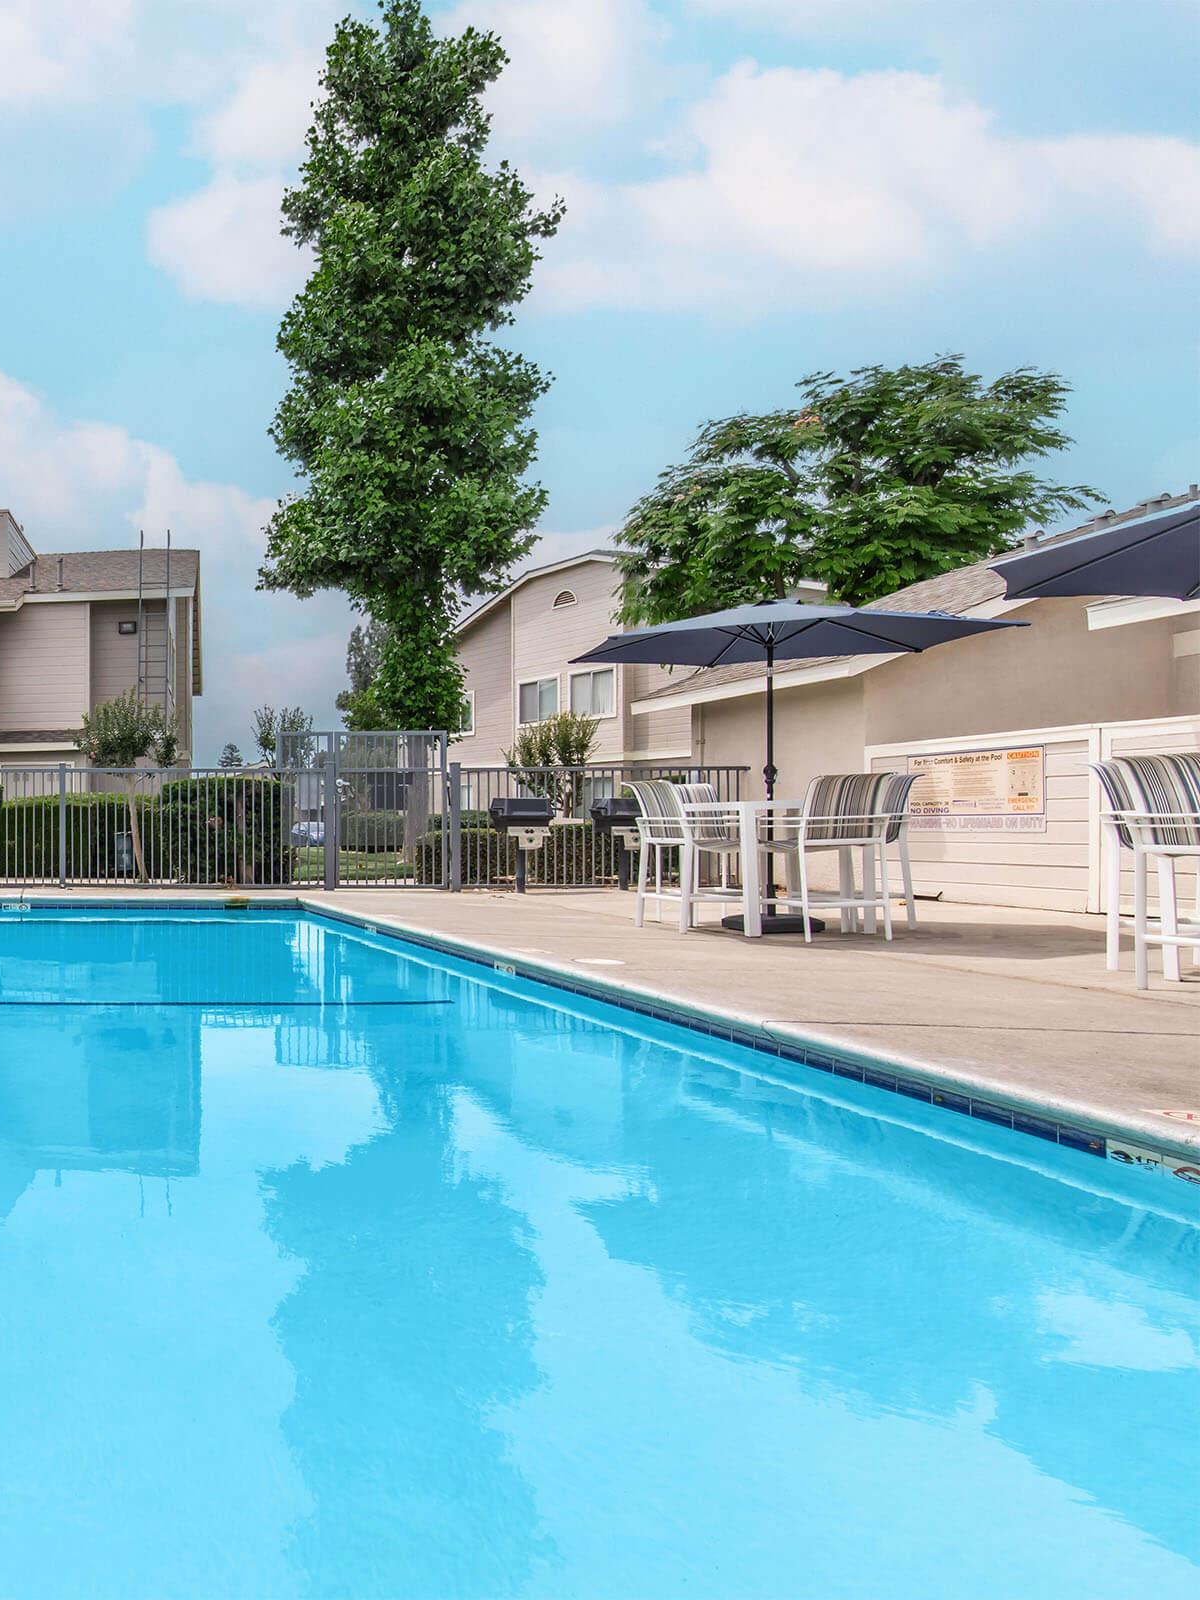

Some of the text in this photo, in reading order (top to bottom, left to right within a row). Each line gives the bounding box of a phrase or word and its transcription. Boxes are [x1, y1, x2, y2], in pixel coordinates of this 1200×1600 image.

[959, 756, 975, 765] Safety
[991, 753, 1002, 761] Pool
[1007, 751, 1040, 759] CAUTION
[1019, 816, 1042, 828] DUTY
